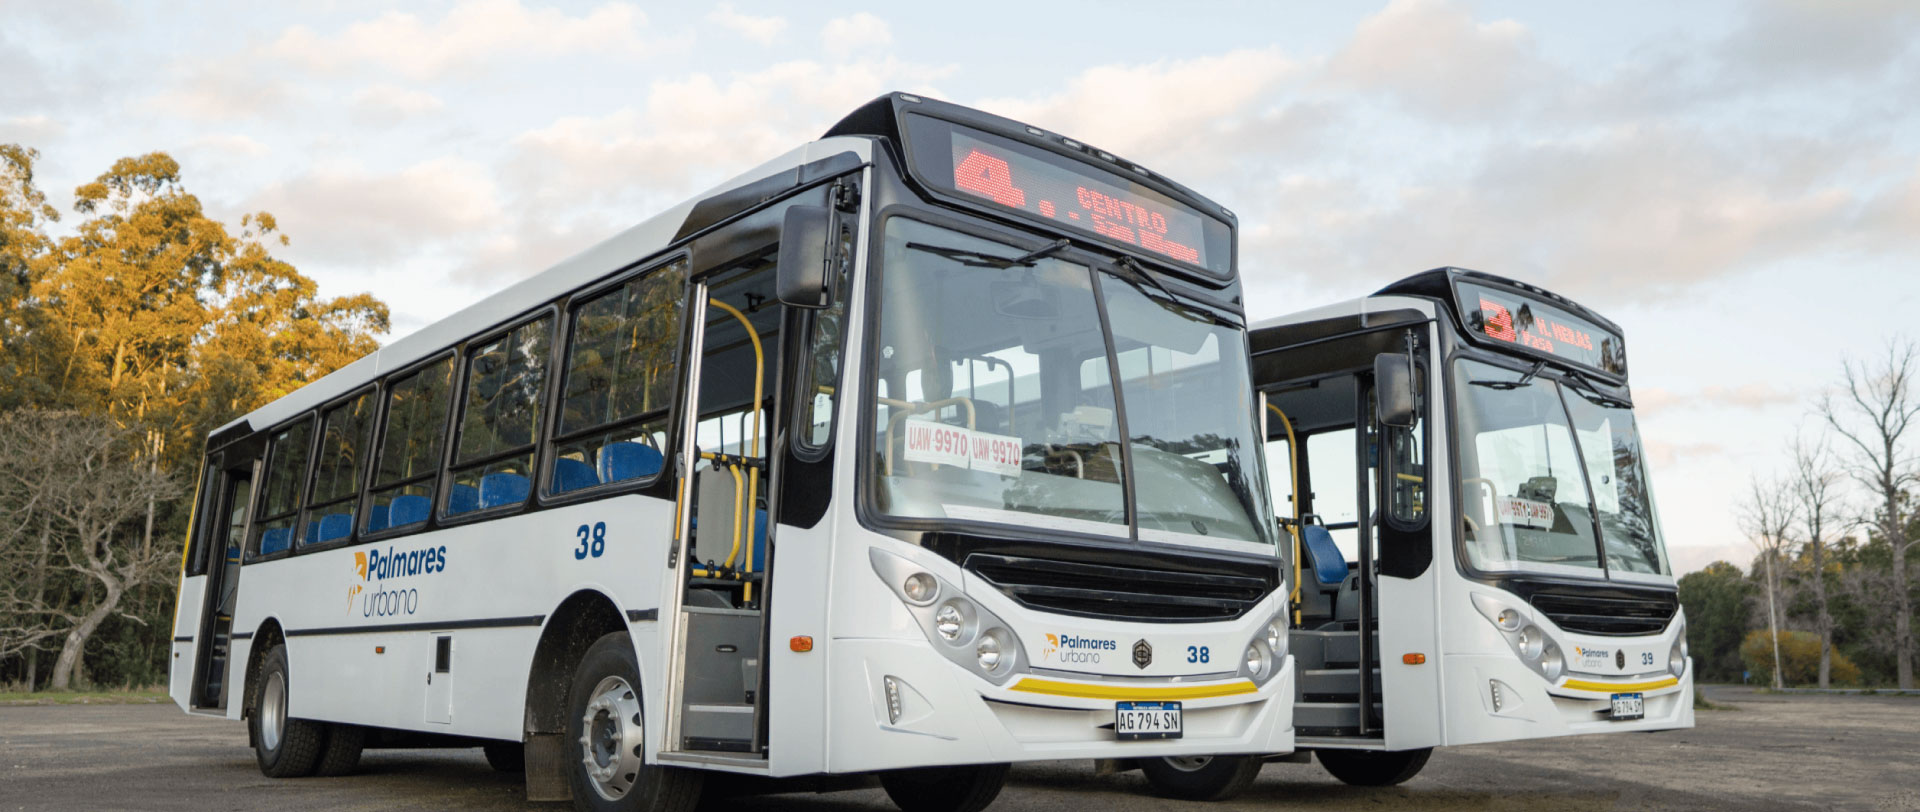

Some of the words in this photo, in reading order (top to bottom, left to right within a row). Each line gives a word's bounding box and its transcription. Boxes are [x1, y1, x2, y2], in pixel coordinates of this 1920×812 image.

[955, 150, 1025, 208] 4
[1077, 186, 1167, 234] CENTRO
[1480, 299, 1516, 343] 3
[574, 521, 606, 560] 38
[367, 545, 446, 581] Palmares
[364, 584, 418, 618] urbano
[1060, 634, 1116, 651] Palmares
[1187, 645, 1210, 664] 38
[1581, 647, 1609, 658] Palmares
[1060, 650, 1101, 664] urbano
[1642, 652, 1654, 665] 39
[1120, 712, 1134, 730] AG
[1138, 712, 1159, 730] 794
[1163, 712, 1178, 730] SN
